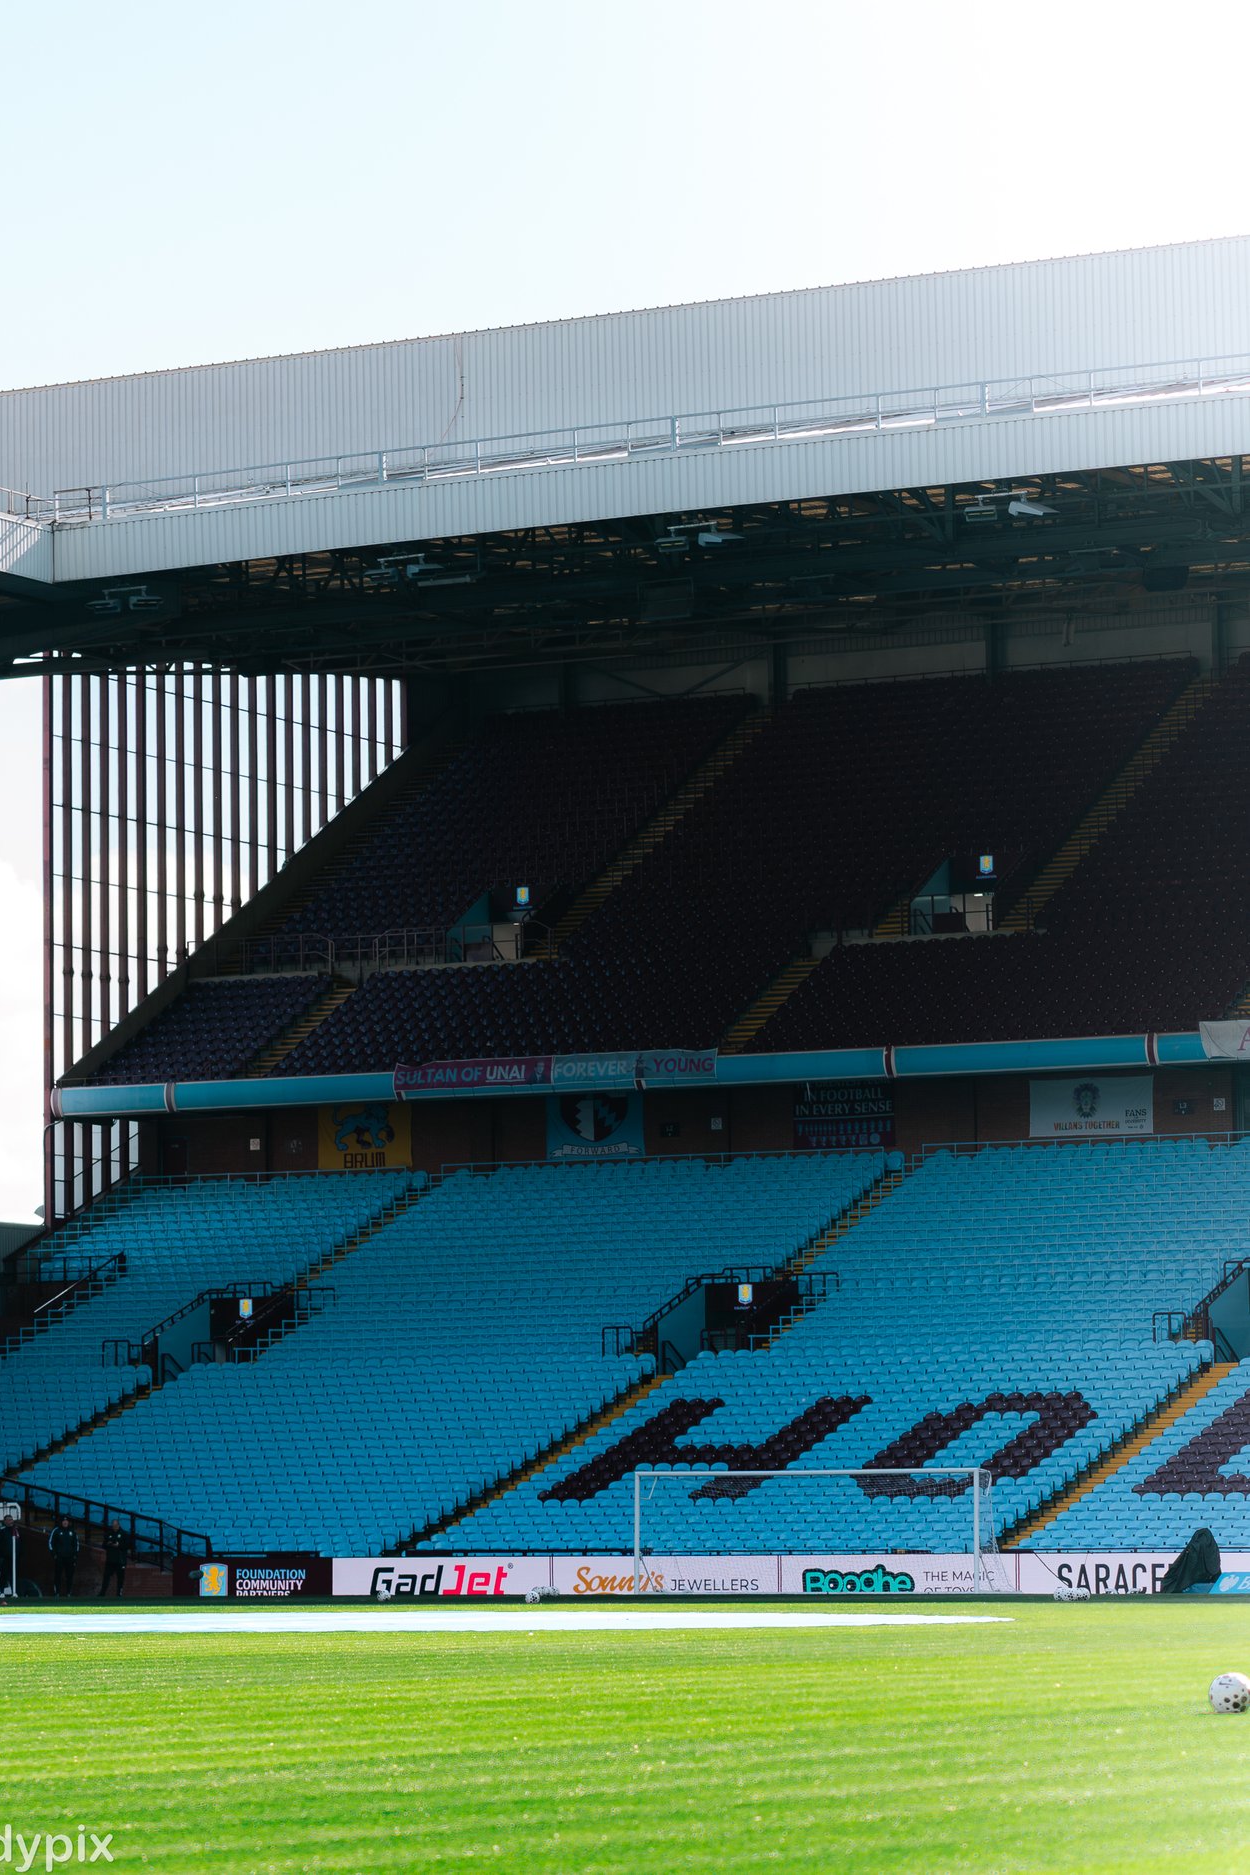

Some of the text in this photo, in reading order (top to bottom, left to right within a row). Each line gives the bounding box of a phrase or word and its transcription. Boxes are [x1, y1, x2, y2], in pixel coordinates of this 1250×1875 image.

[395, 1057, 714, 1085] SULTAN OF UNAI FOREVER YOUNG
[821, 1087, 884, 1101] FOOTBALL
[795, 1100, 893, 1116] IN EVERY SENSE
[1125, 1108, 1147, 1117] FANS
[1054, 1120, 1120, 1131] VILLANS TOGETHER
[570, 1145, 620, 1155] FORWARD
[344, 1152, 386, 1168] BRUM
[235, 1569, 306, 1580] FOUNDATION
[923, 1571, 948, 1582] THE
[1057, 1563, 1174, 1594] SARACE
[235, 1579, 304, 1591] COMMUNITY
[670, 1578, 759, 1592] JEWELLERS
